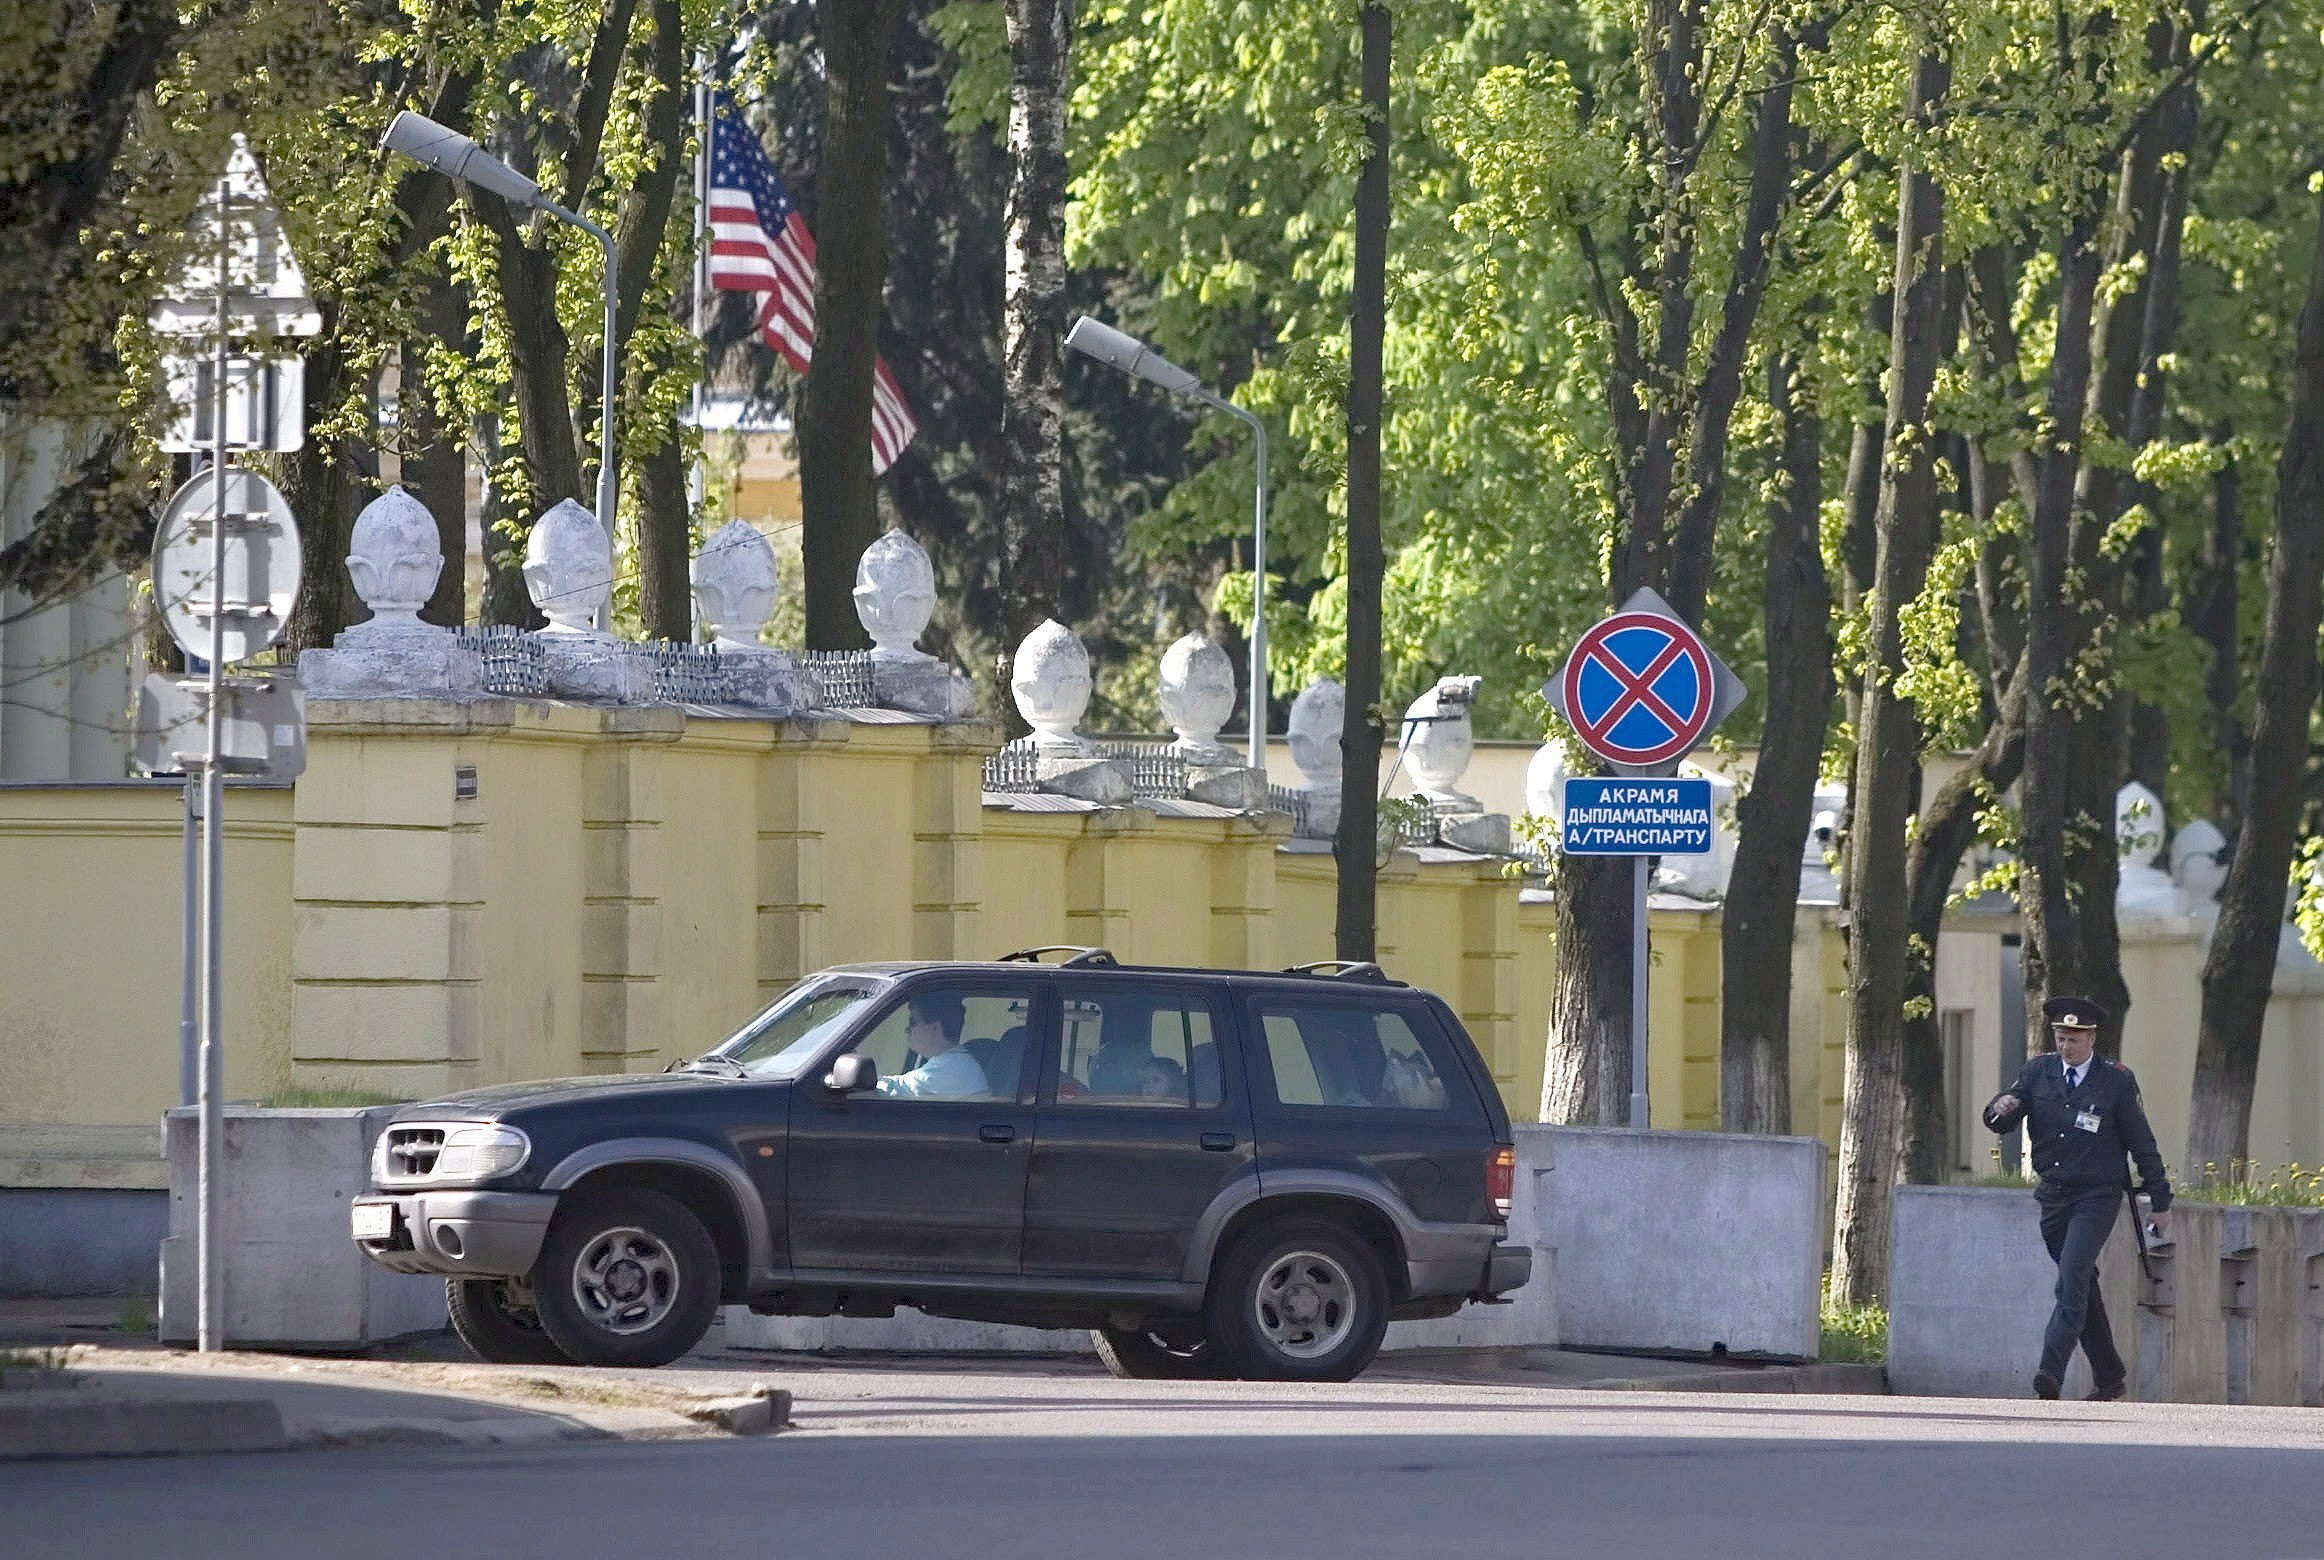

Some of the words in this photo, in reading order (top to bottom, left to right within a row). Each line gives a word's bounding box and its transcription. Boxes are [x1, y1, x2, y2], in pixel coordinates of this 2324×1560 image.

[1599, 788, 1679, 804] АКРАМЯ
[1567, 808, 1708, 826] ДЫПЛАМАТЫЧНАГА
[1568, 828, 1706, 845] А/ТРАНСПАРТУ
